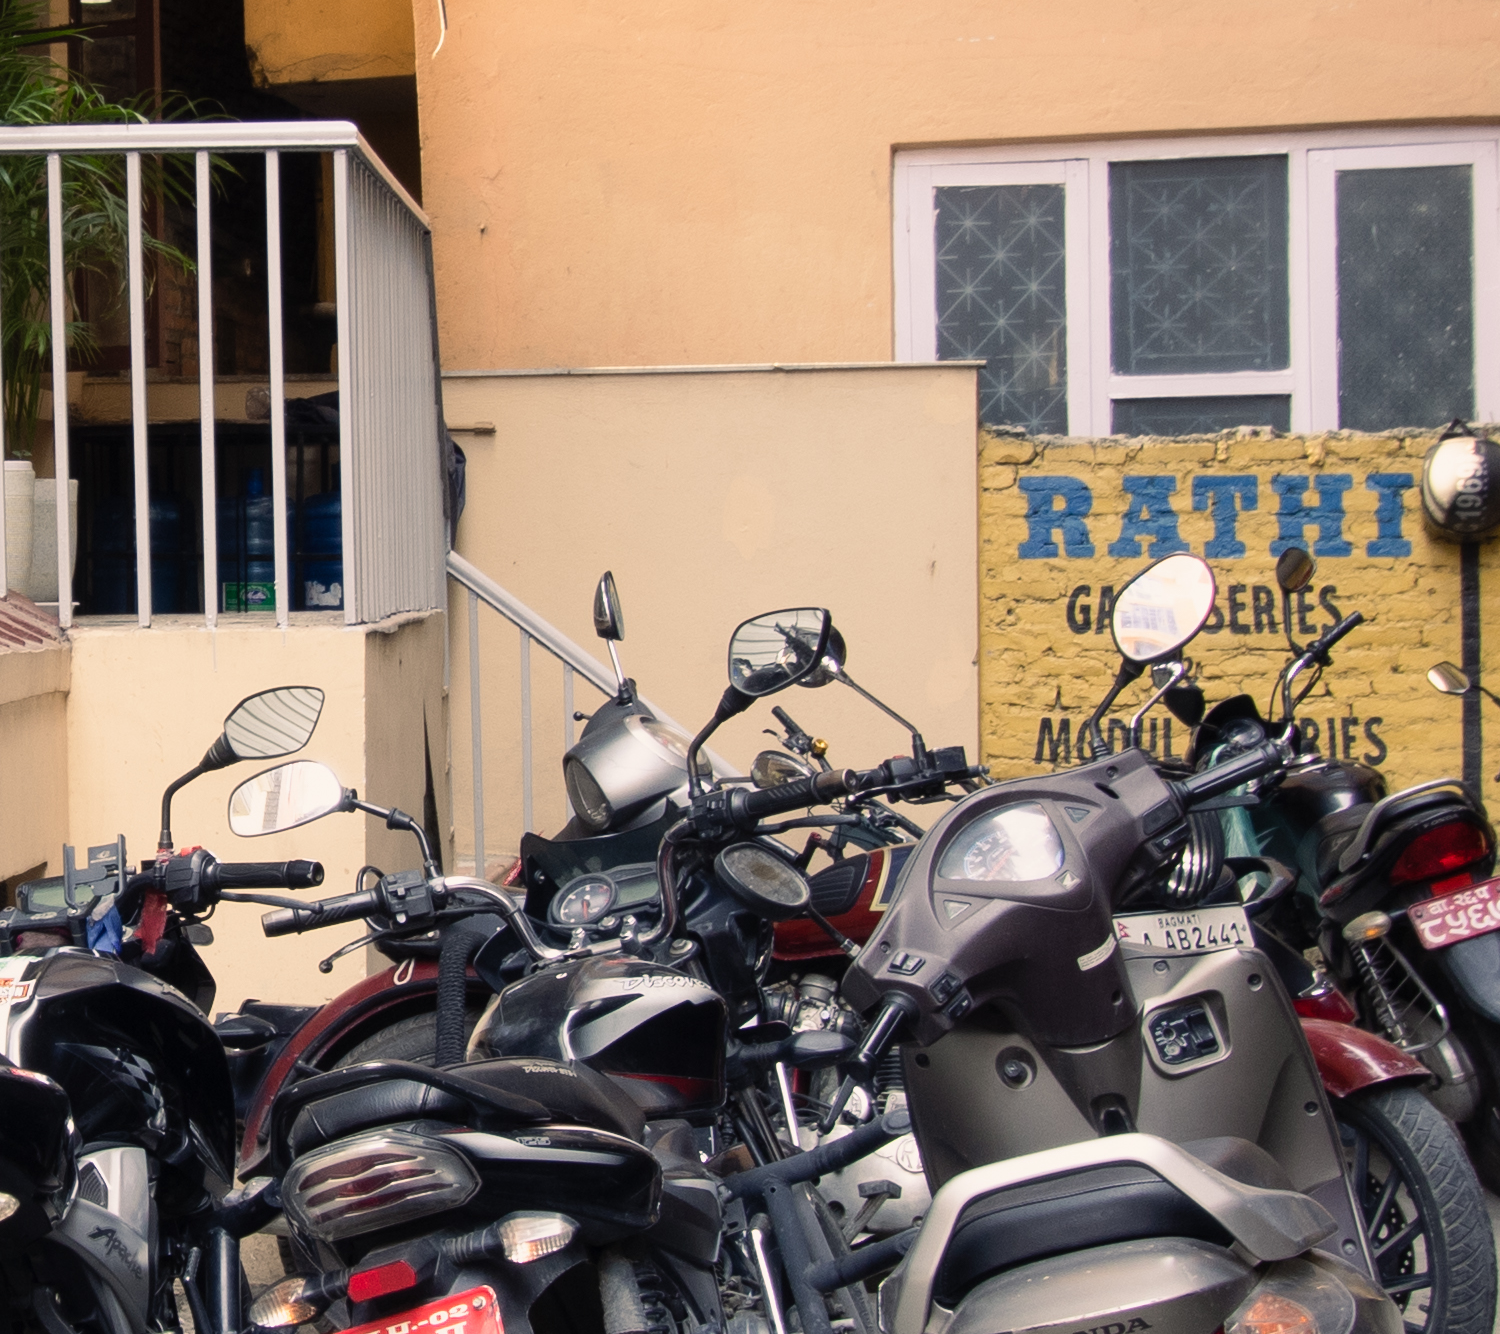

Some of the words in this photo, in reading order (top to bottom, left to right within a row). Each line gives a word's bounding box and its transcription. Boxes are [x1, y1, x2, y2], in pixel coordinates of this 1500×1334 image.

[1018, 473, 1414, 559] RATHI
[1157, 914, 1201, 929] BAGMATI
[87, 1225, 143, 1280] Apache
